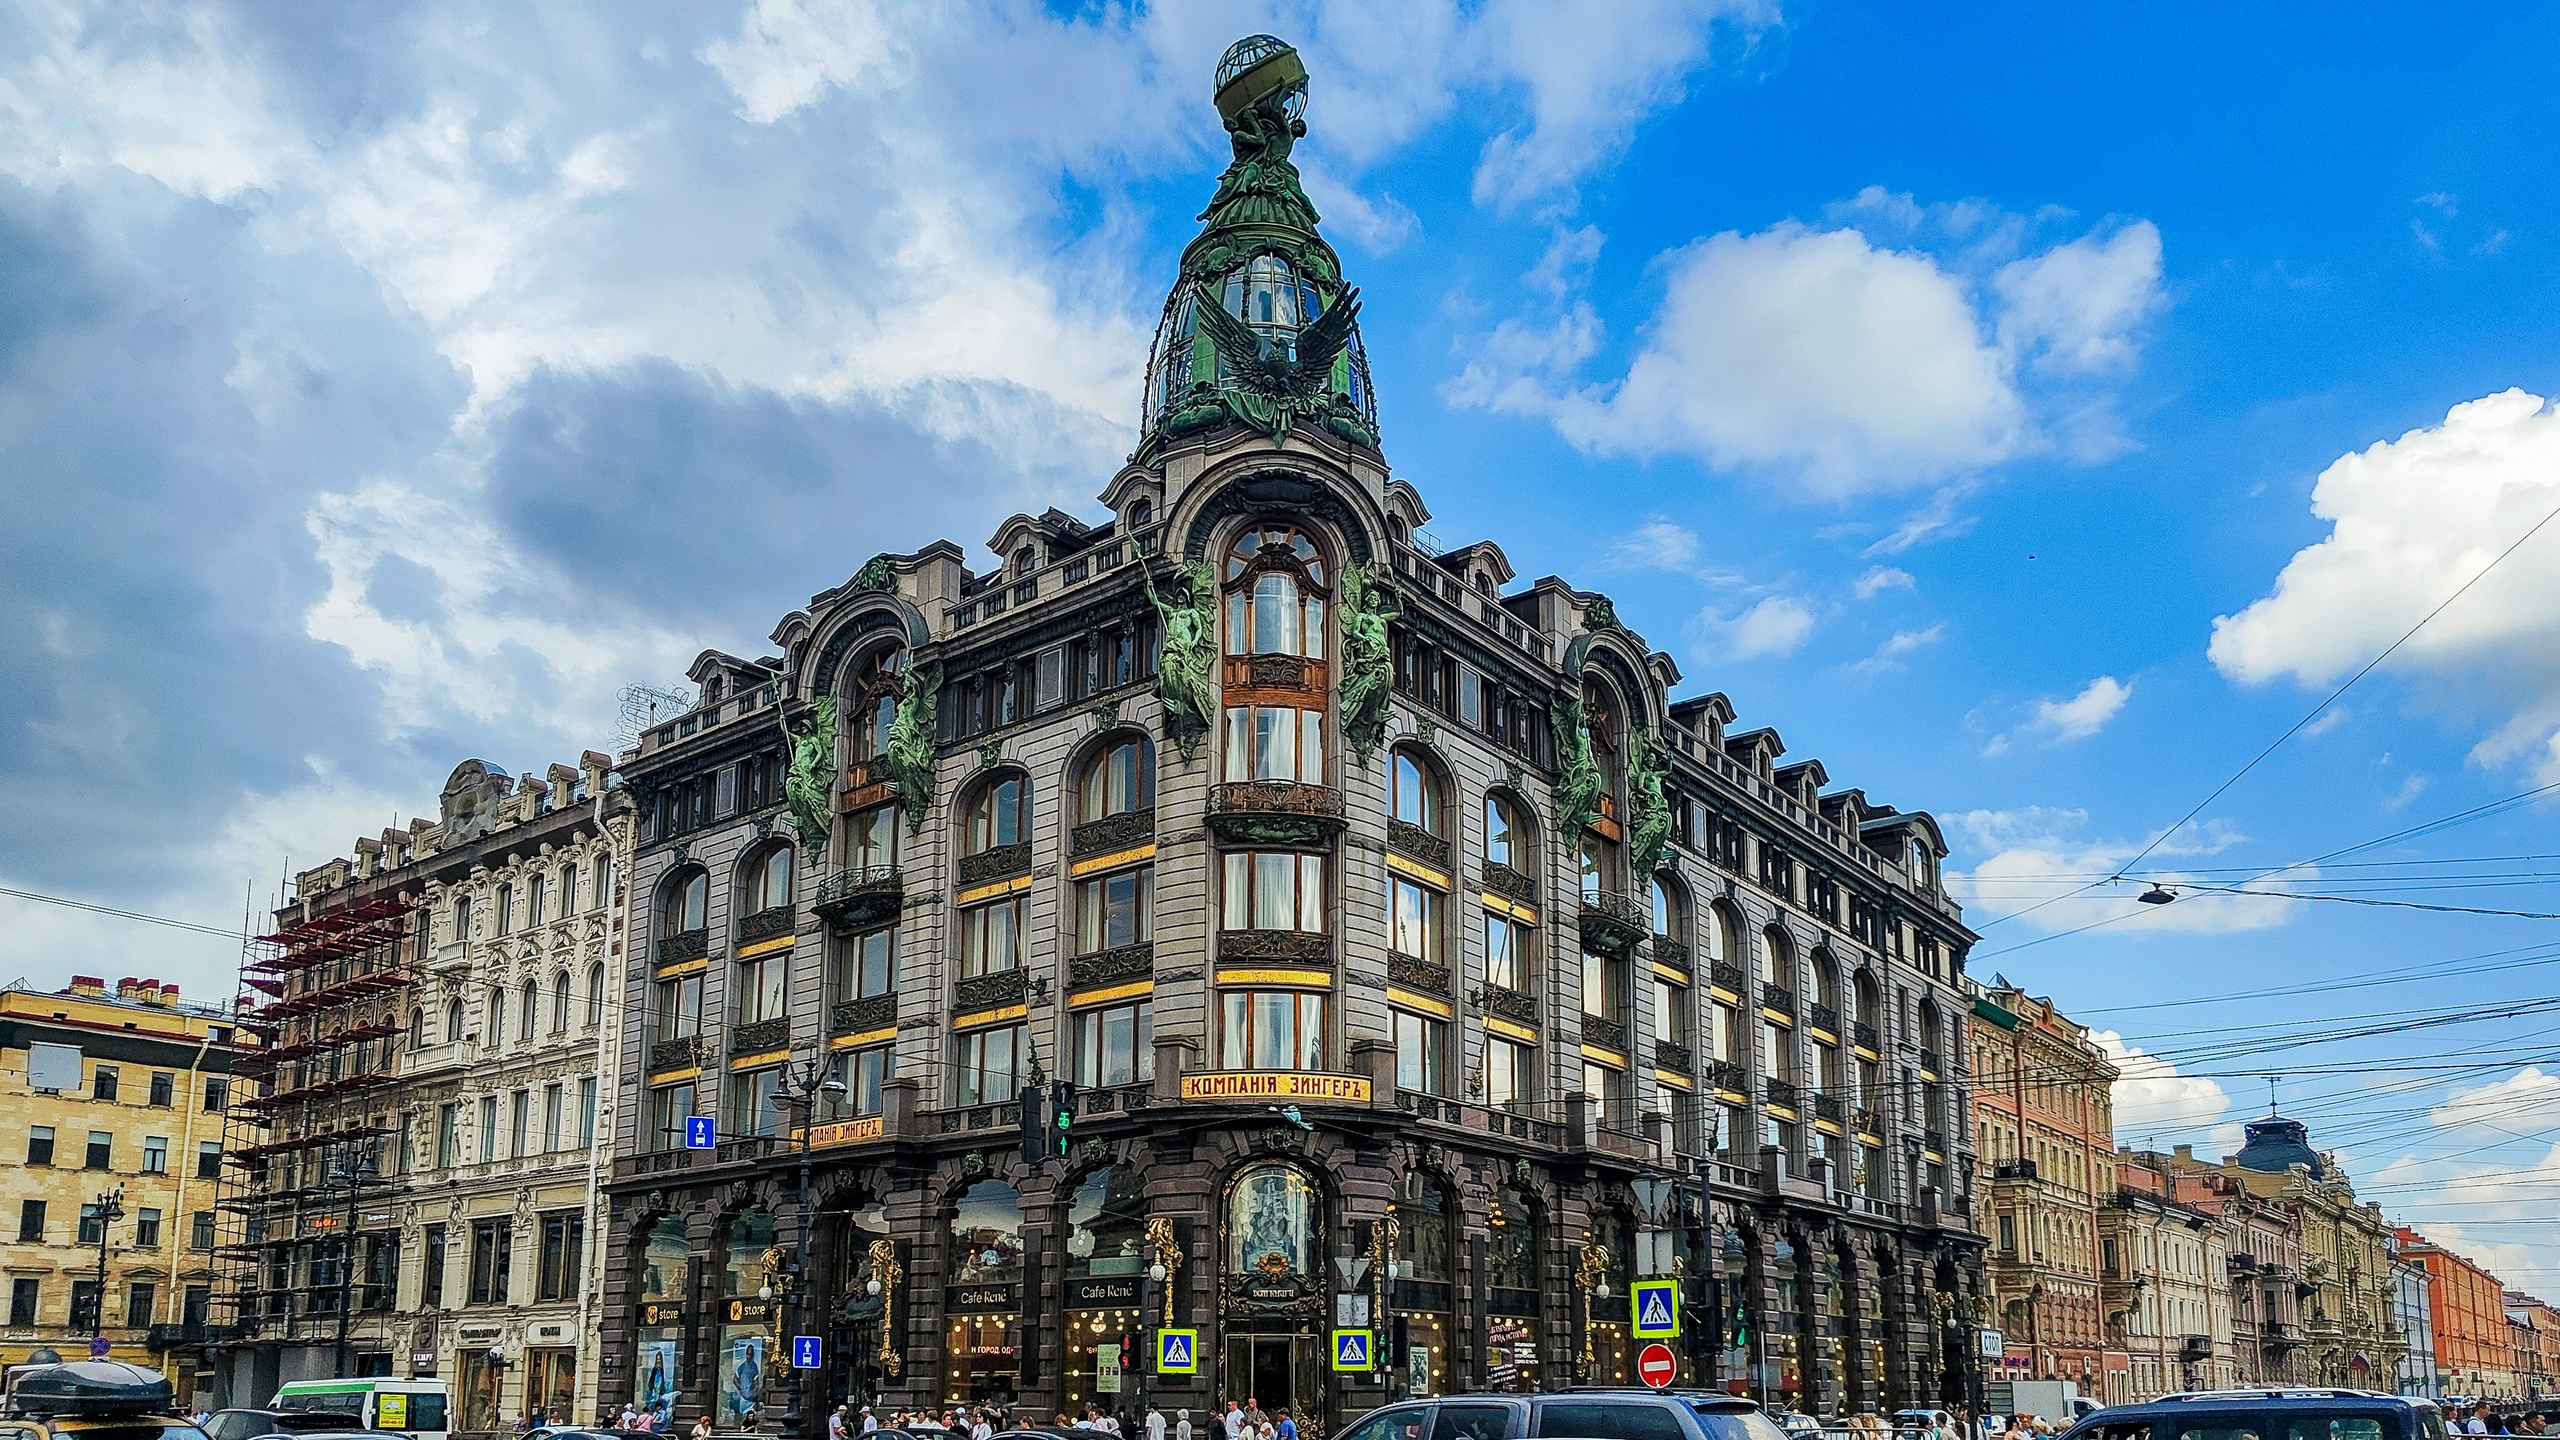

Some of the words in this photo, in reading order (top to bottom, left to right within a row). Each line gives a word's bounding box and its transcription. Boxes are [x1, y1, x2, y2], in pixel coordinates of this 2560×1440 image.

[1190, 1076, 1277, 1095] КОМПАНІЯ
[1290, 1076, 1361, 1098] ЗИНГЕРЪ
[961, 1292, 983, 1304] Cafe
[984, 1288, 1007, 1303] René
[1081, 1286, 1106, 1299] Cafe
[1107, 1282, 1134, 1298] René
[659, 1307, 679, 1320] store
[744, 1303, 766, 1316] store
